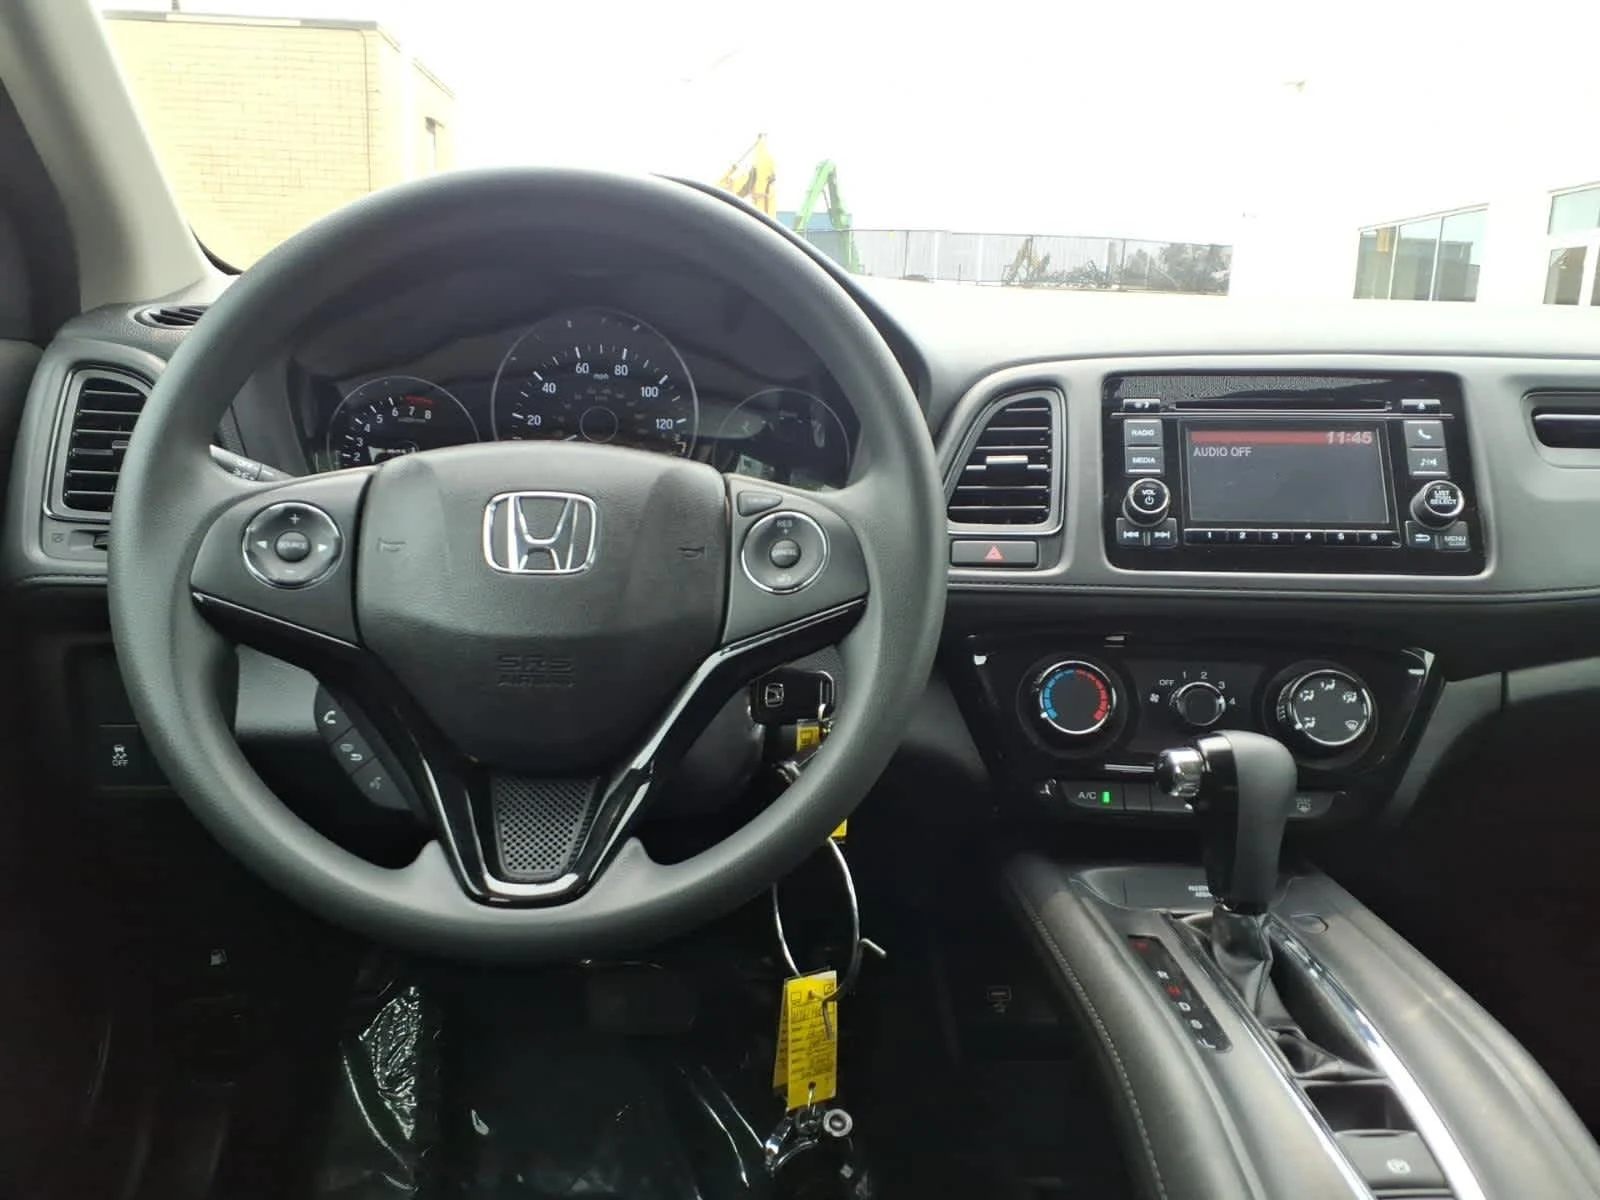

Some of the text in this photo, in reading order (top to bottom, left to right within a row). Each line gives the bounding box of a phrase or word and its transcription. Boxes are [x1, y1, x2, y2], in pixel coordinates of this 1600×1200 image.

[575, 362, 590, 374] 60
[613, 364, 629, 376] 80
[541, 382, 557, 394] 40
[640, 385, 660, 398] 100
[391, 407, 399, 417] 6
[408, 405, 415, 416] 7
[424, 409, 432, 420] 8
[376, 414, 383, 424] 5
[526, 414, 542, 426] 20
[655, 418, 673, 430] 120
[363, 423, 371, 433] 4
[1131, 429, 1155, 437] RADIO
[356, 436, 364, 447] 3
[1325, 431, 1373, 445] 11:45
[353, 451, 361, 461] 2
[1193, 446, 1252, 457] AUDIO OFF
[1239, 531, 1247, 540] 2
[1271, 532, 1279, 540] 3
[1304, 532, 1312, 540] 4
[1200, 671, 1208, 680] 2
[1159, 679, 1175, 687] OFF
[1218, 680, 1226, 690] 3
[1229, 697, 1236, 705] 4
[1078, 791, 1097, 800] A/C
